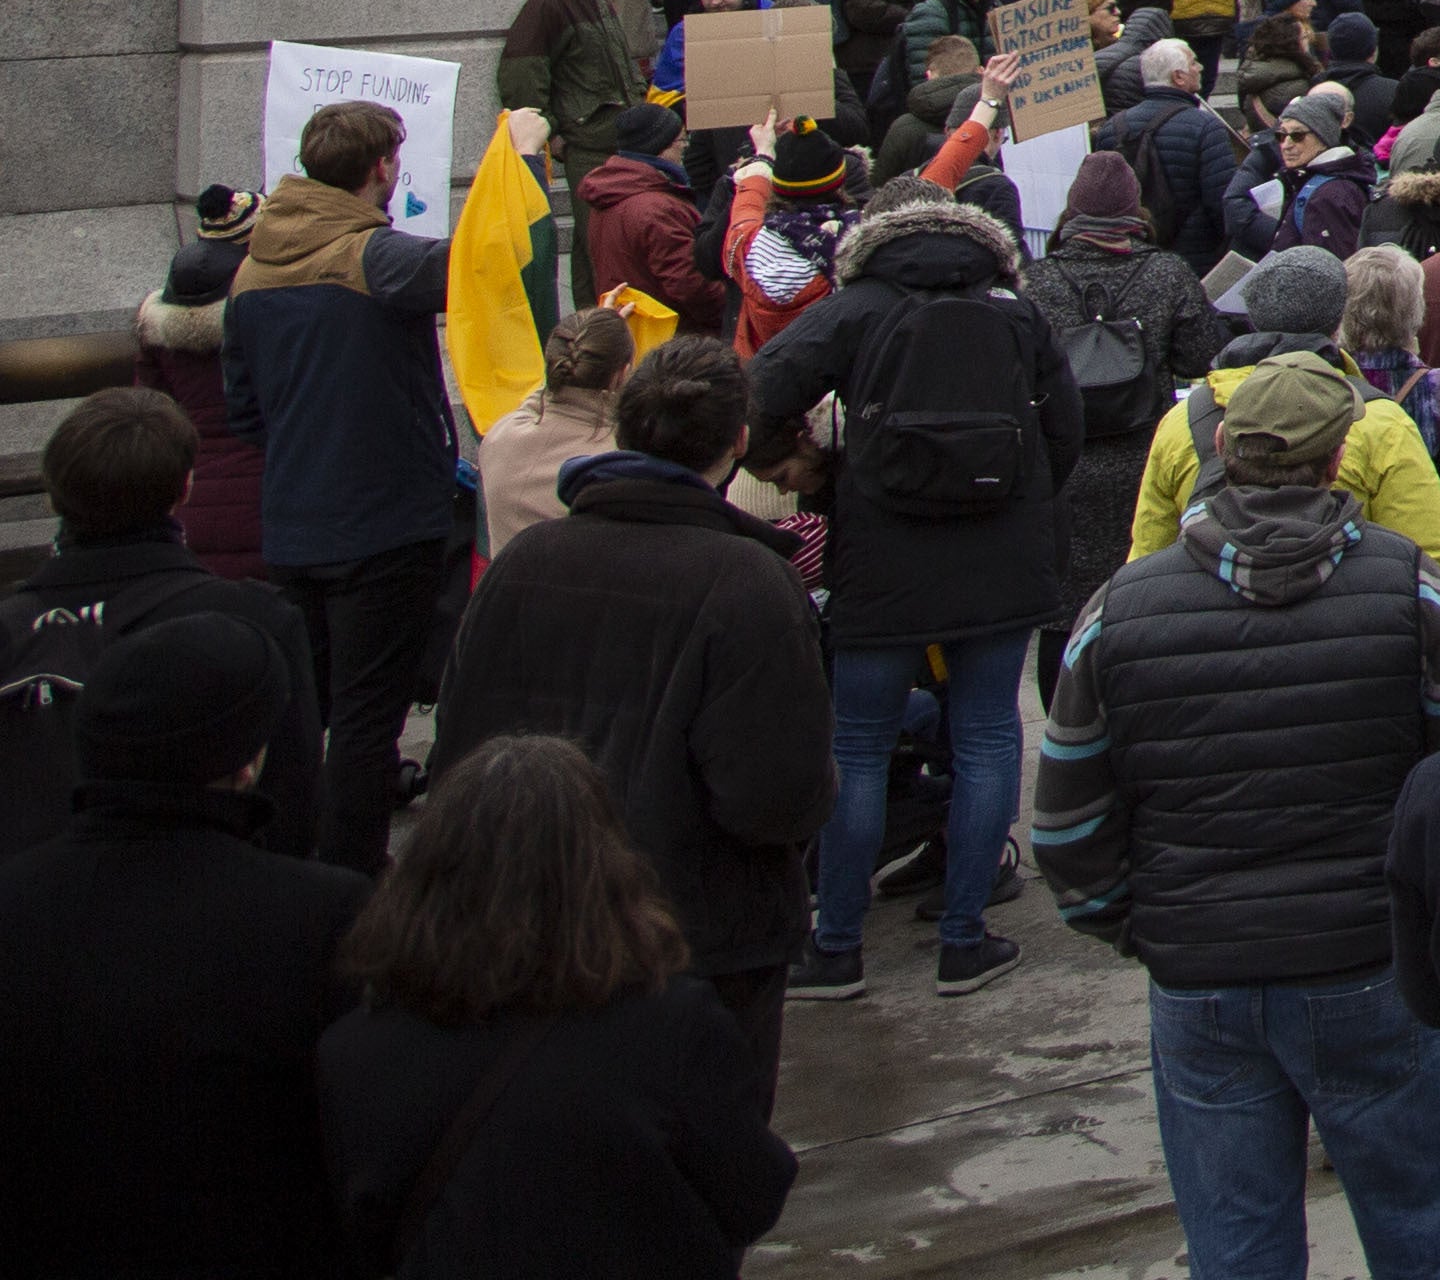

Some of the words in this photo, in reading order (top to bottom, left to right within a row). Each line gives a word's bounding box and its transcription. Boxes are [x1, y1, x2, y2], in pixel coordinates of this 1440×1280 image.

[1003, 21, 1053, 53] INTACT
[1019, 36, 1090, 69] ANITARIAN
[1039, 58, 1084, 81] SUPPLY
[300, 68, 353, 95] STOP
[360, 73, 432, 105] FUNDING
[1014, 95, 1027, 110] IN
